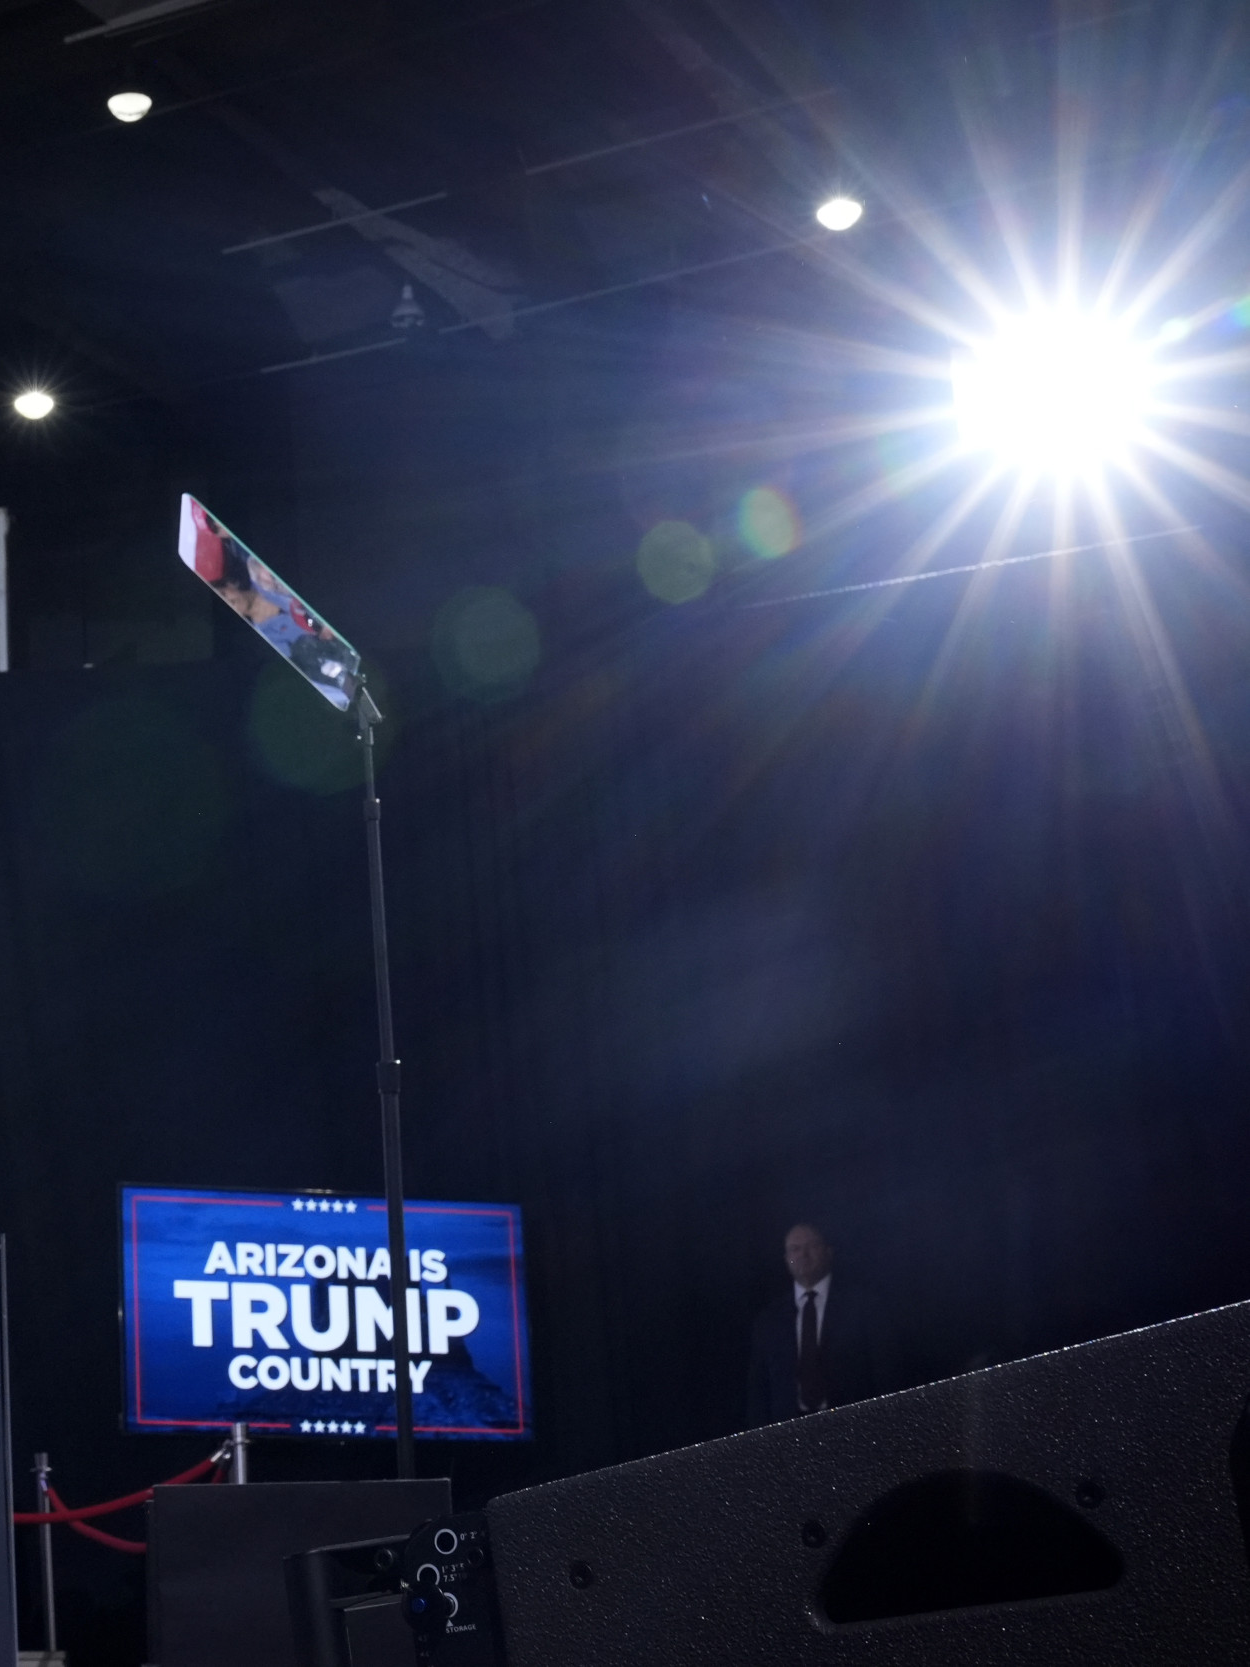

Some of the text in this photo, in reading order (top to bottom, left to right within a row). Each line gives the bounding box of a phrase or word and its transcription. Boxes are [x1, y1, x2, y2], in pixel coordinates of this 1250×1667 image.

[203, 1241, 448, 1283] ARIZONA IS
[173, 1279, 480, 1355] TRUMP
[227, 1354, 433, 1394] COUNTRY
[445, 1623, 477, 1634] STORAGE
